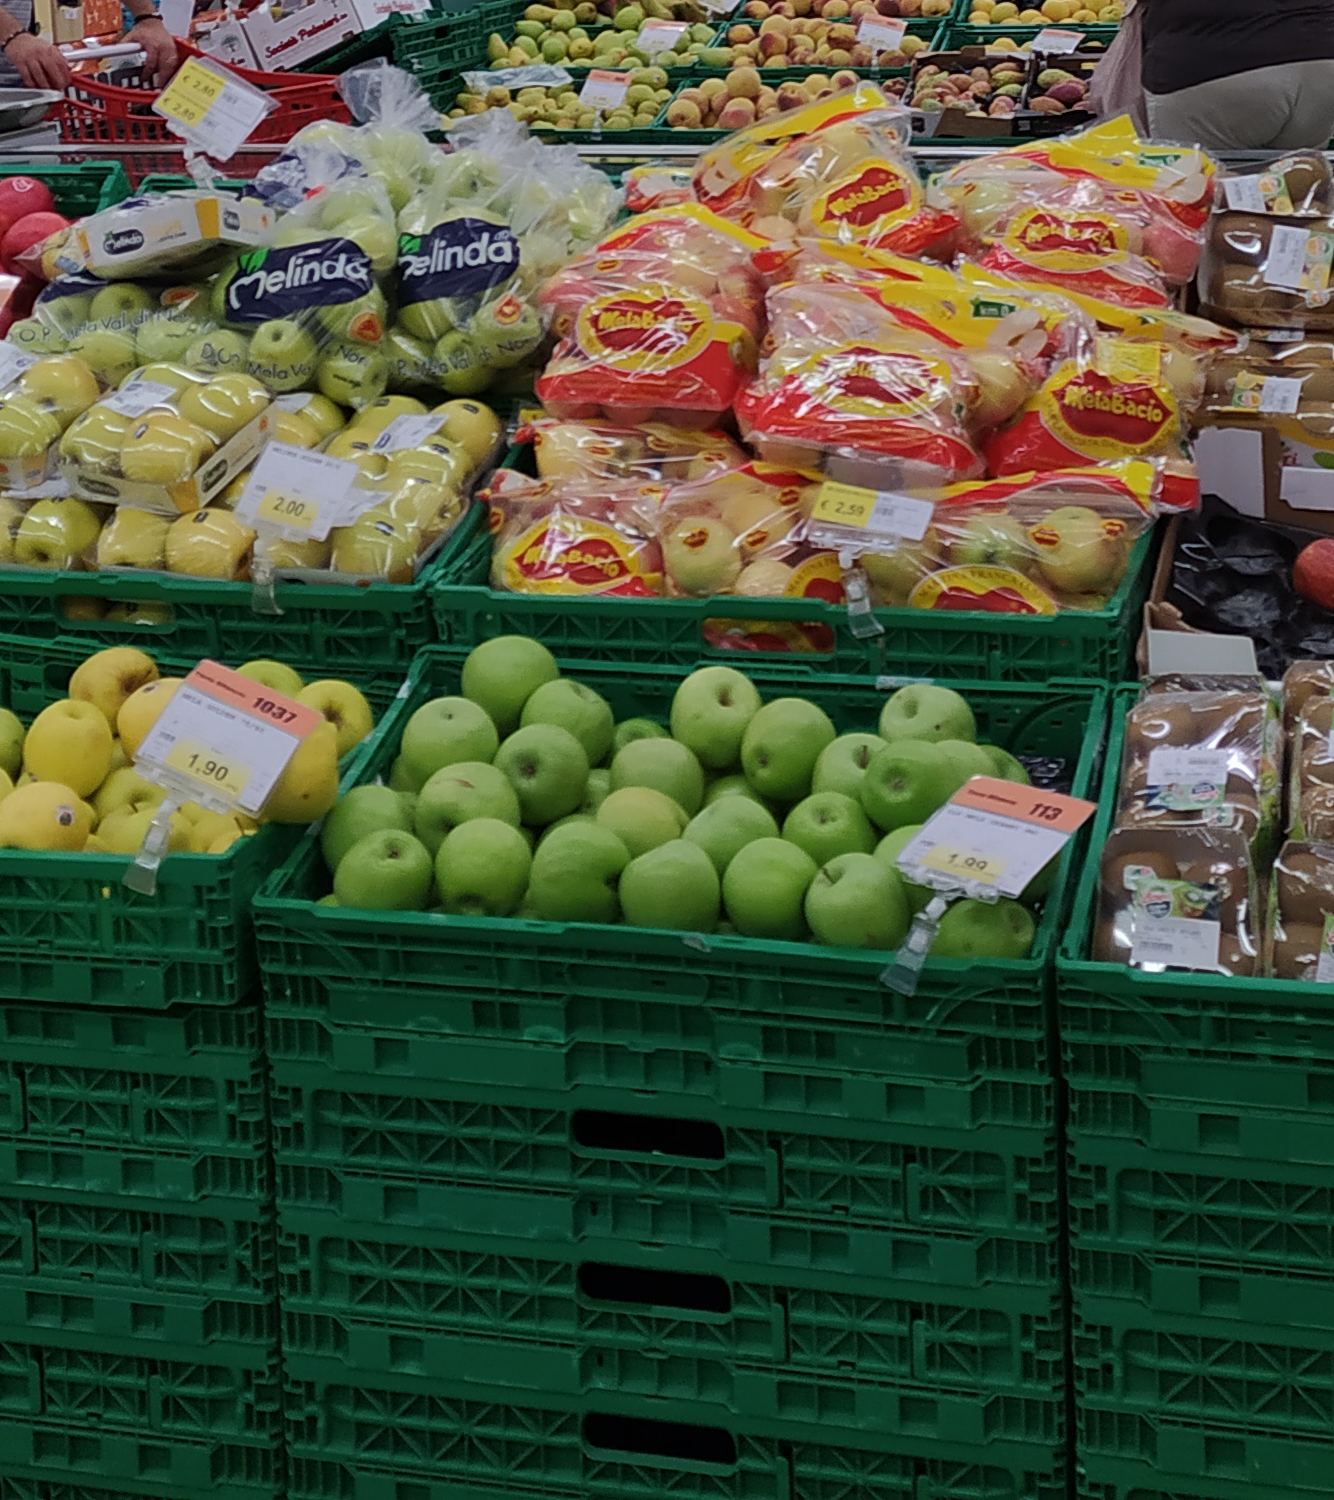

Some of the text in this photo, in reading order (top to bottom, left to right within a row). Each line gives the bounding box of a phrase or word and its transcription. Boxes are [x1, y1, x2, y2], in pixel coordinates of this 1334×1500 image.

[228, 254, 369, 310] Melinda
[100, 316, 126, 330] Val
[1064, 384, 1164, 423] MelaBacio
[252, 697, 298, 724] 1037
[1028, 802, 1064, 822] 113
